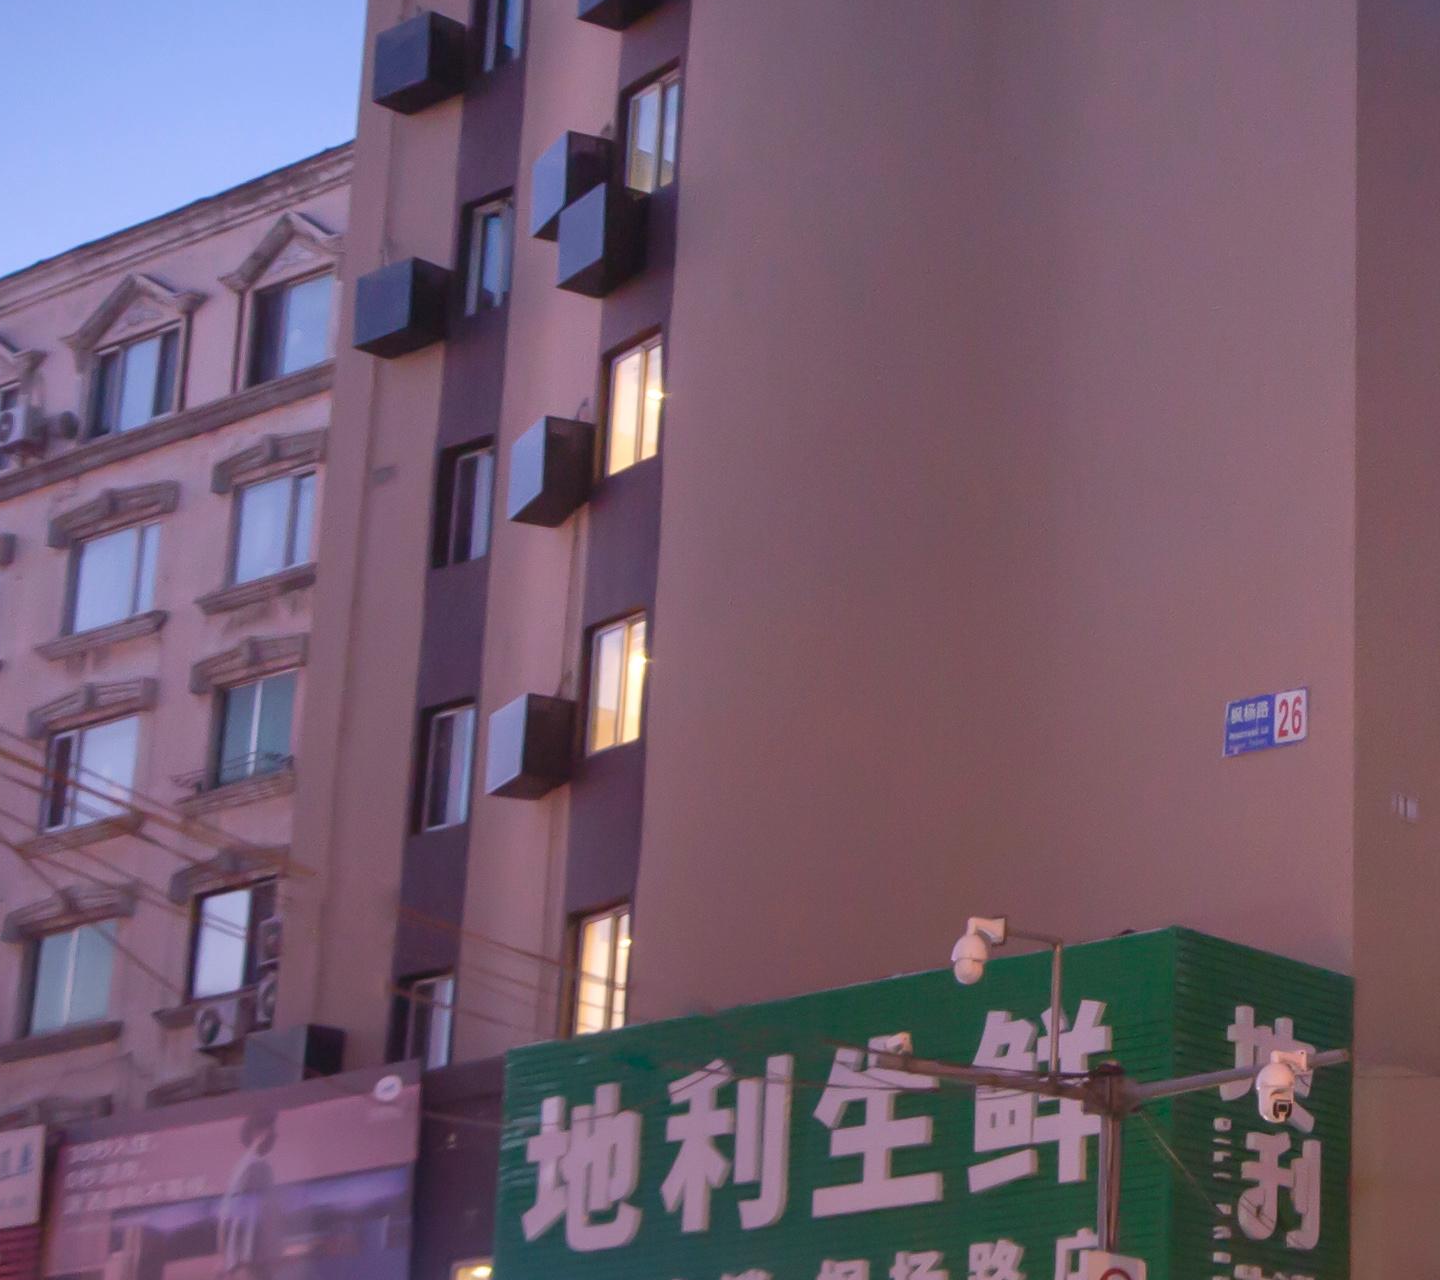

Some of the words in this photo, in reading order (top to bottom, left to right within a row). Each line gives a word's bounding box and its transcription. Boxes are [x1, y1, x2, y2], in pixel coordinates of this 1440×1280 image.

[1278, 696, 1303, 737] 26
[520, 999, 1113, 1253] 地利生鲜
